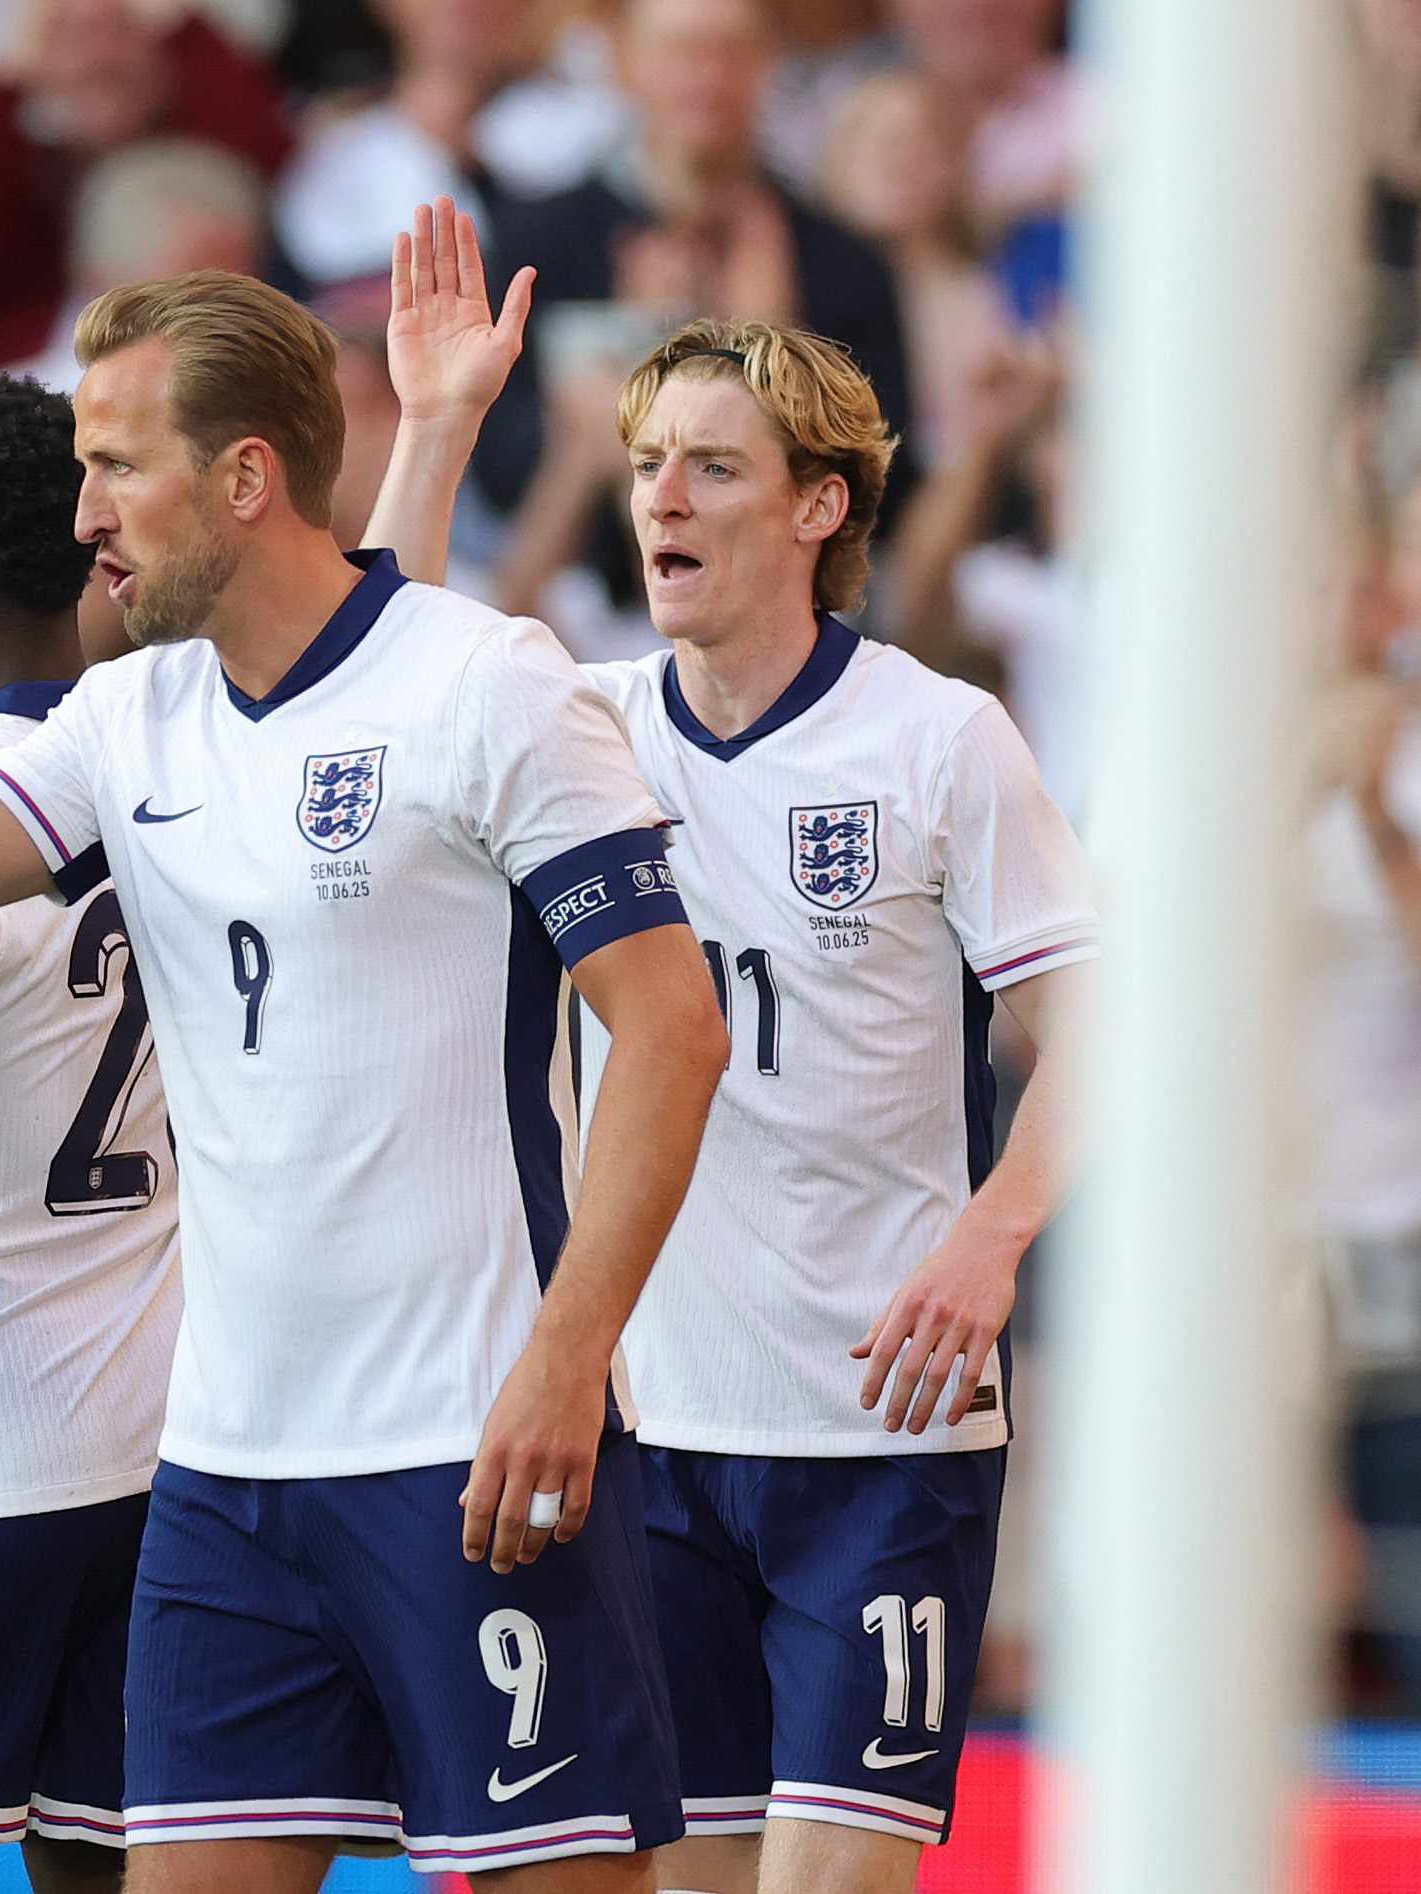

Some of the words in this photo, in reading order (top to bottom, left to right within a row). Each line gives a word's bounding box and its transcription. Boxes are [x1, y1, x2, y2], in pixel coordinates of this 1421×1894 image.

[311, 859, 371, 879] SENEGAL
[316, 881, 370, 901] 10.06.25
[809, 913, 871, 931] SENEGAL
[816, 929, 869, 951] 10.06.25
[227, 919, 275, 1055] 9
[45, 888, 180, 1217] 2
[478, 1608, 547, 1749] 9
[862, 1594, 946, 1732] 11
